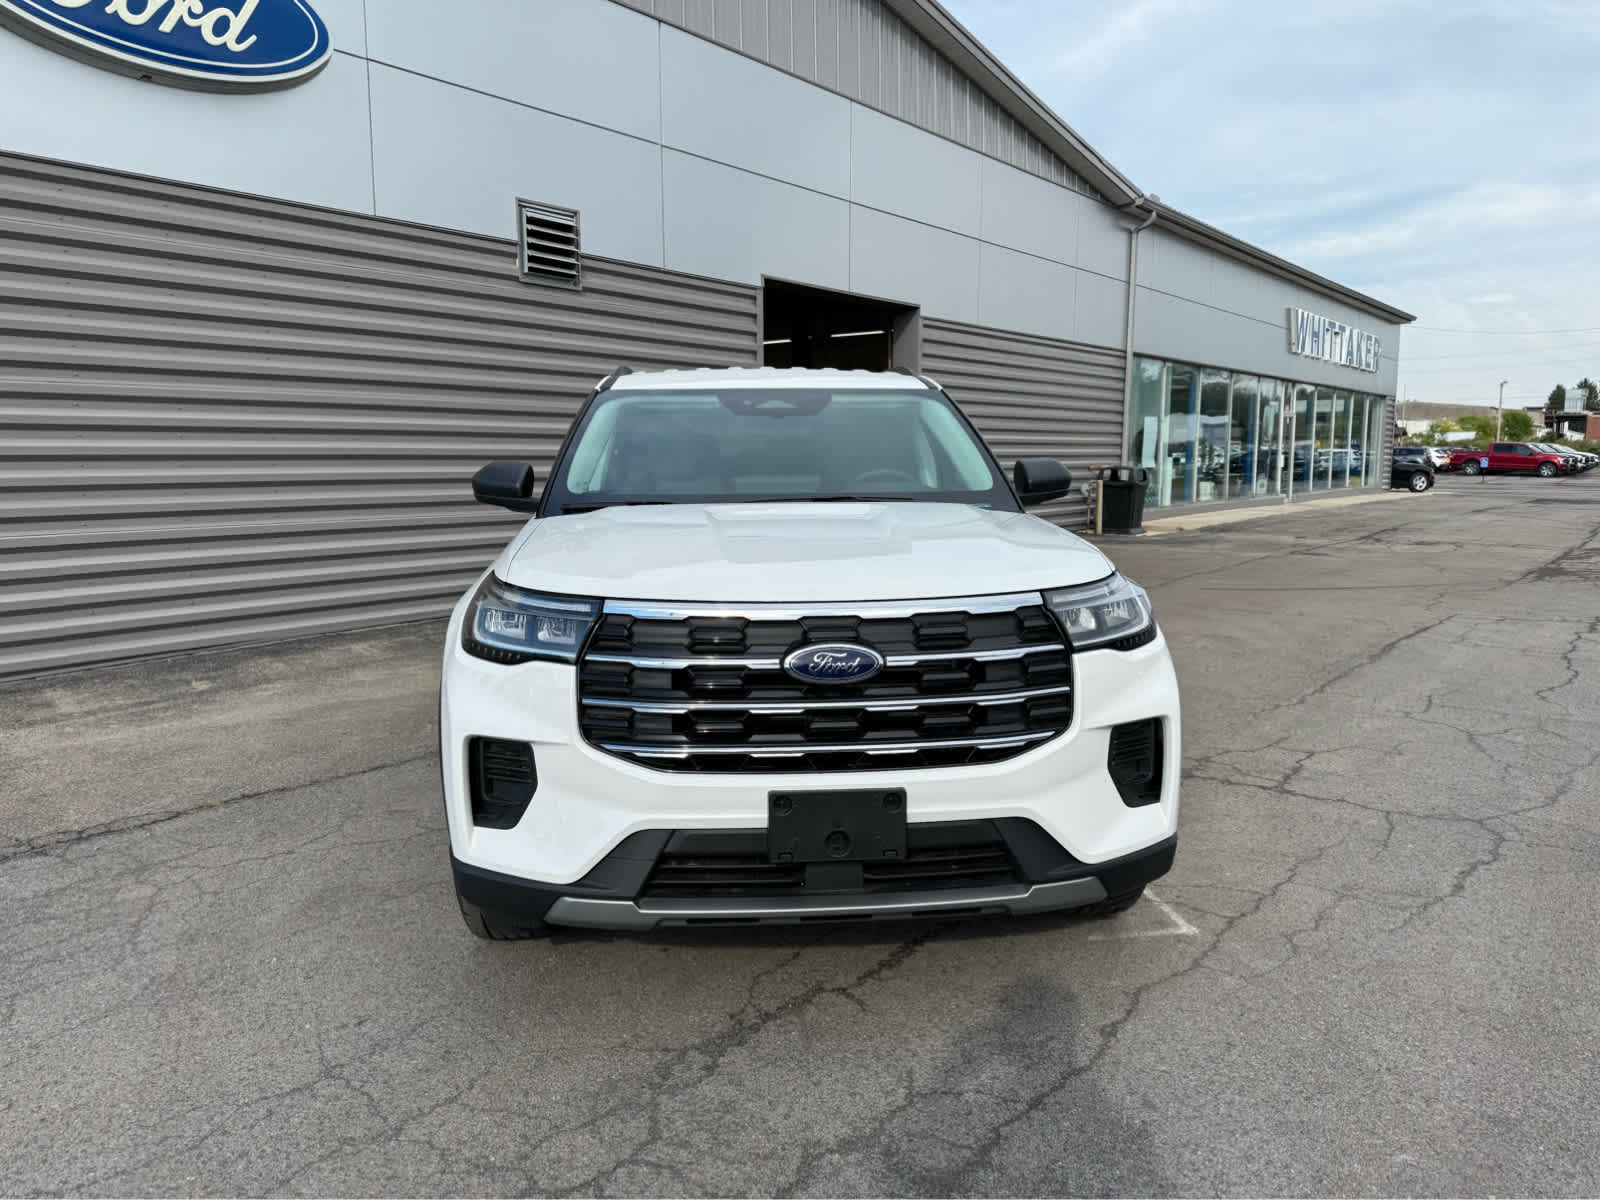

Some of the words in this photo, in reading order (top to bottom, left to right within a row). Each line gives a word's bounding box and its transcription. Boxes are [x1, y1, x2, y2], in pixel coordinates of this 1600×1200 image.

[50, 0, 258, 52] ord
[1290, 308, 1380, 372] WHITTAKER
[808, 652, 861, 672] Ford
